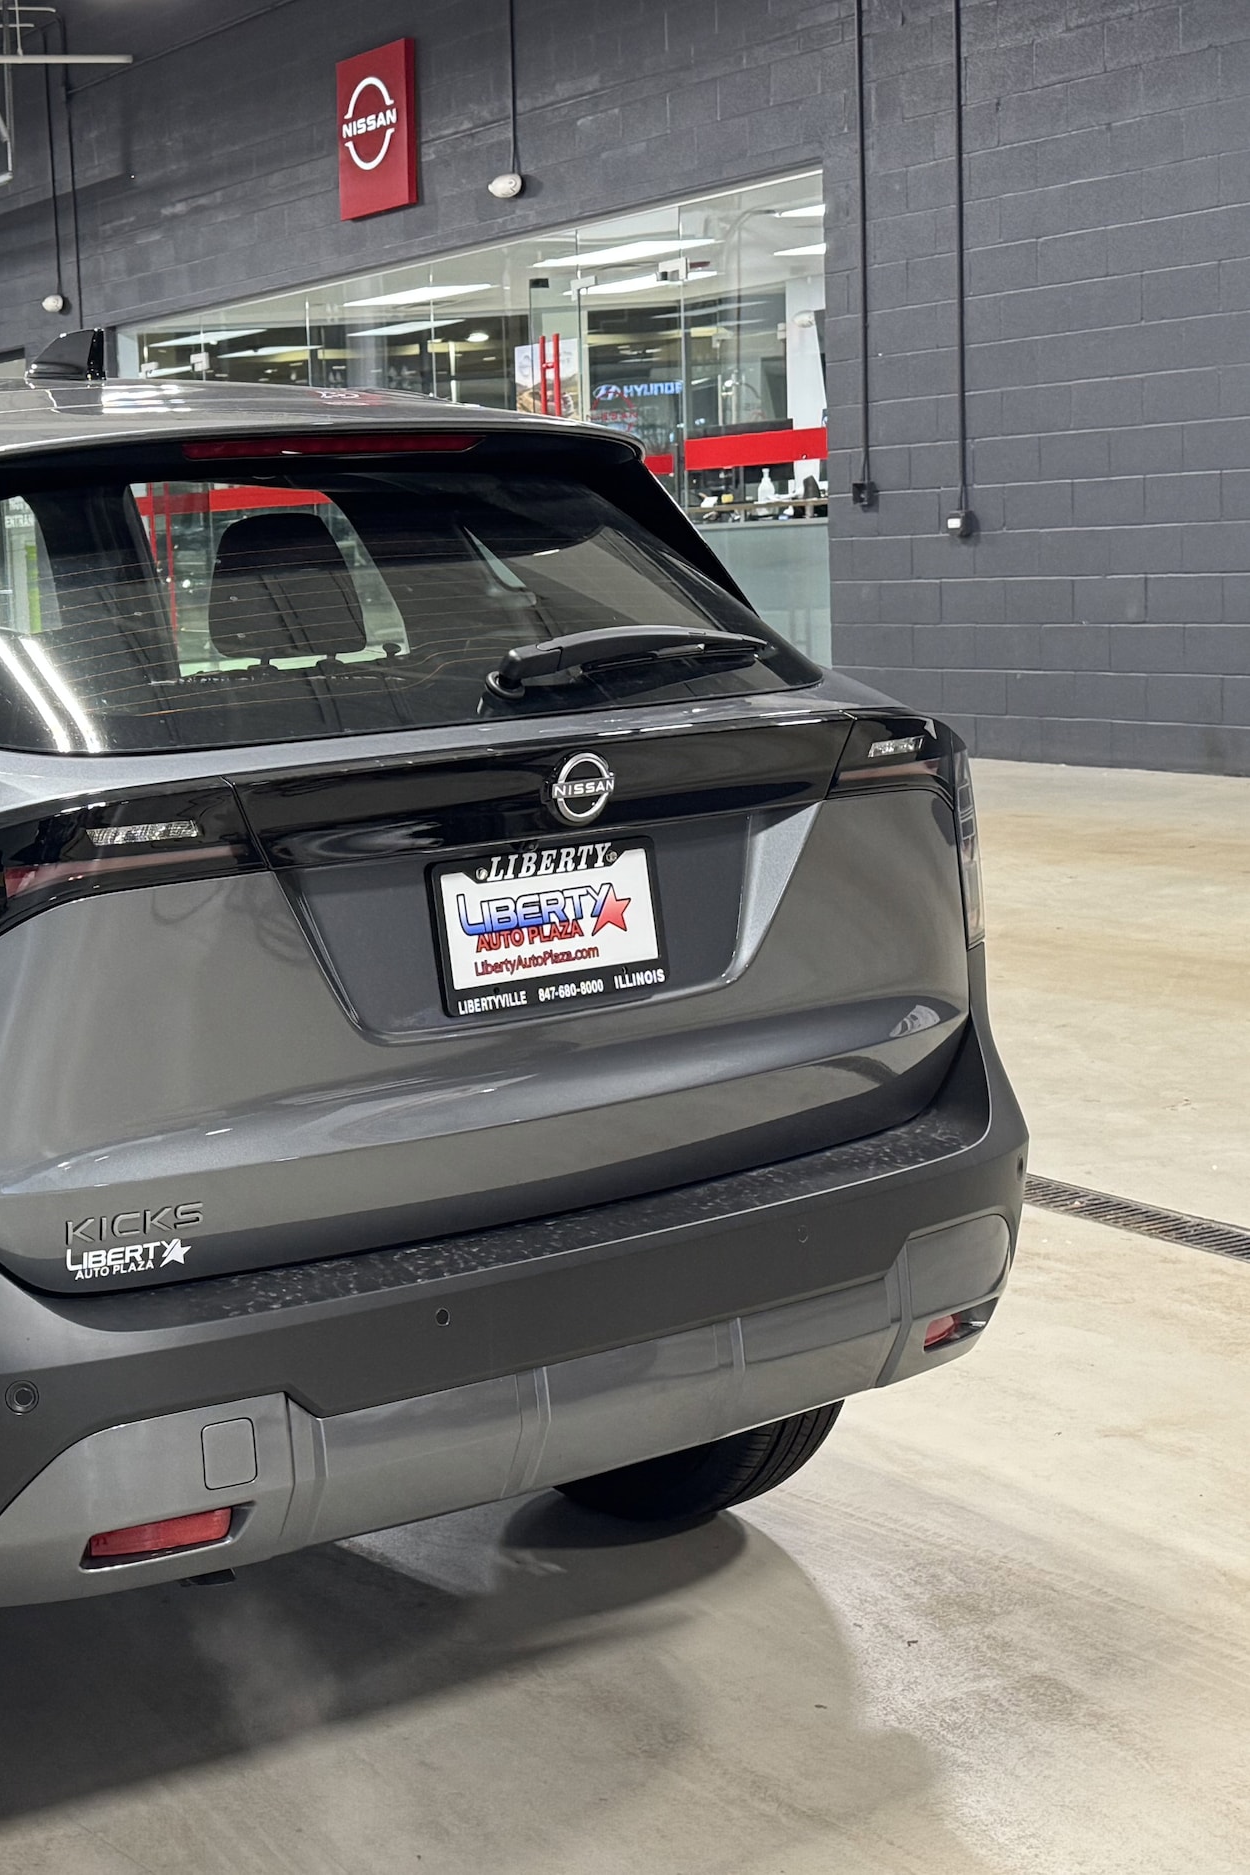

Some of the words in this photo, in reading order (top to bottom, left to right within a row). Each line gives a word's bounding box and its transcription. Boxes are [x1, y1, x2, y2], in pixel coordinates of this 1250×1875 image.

[342, 108, 397, 138] NISSAN
[623, 382, 685, 397] HYUNDA
[553, 778, 615, 798] NISSAN
[487, 842, 612, 882] LIBERTY
[456, 883, 613, 936] LIBERTY
[476, 929, 524, 953] AUTO
[528, 919, 584, 944] PLAZA
[474, 945, 599, 976] LibertyAutoPlaza.com
[458, 991, 527, 1015] LIBERTYVILLE
[538, 979, 604, 1001] 847-680-8000
[614, 969, 665, 989] ILLINOIS
[65, 1201, 203, 1245] KICKS
[66, 1238, 181, 1271] LIBERTY
[75, 1265, 109, 1280] AUTO
[113, 1260, 154, 1275] PLAZA
